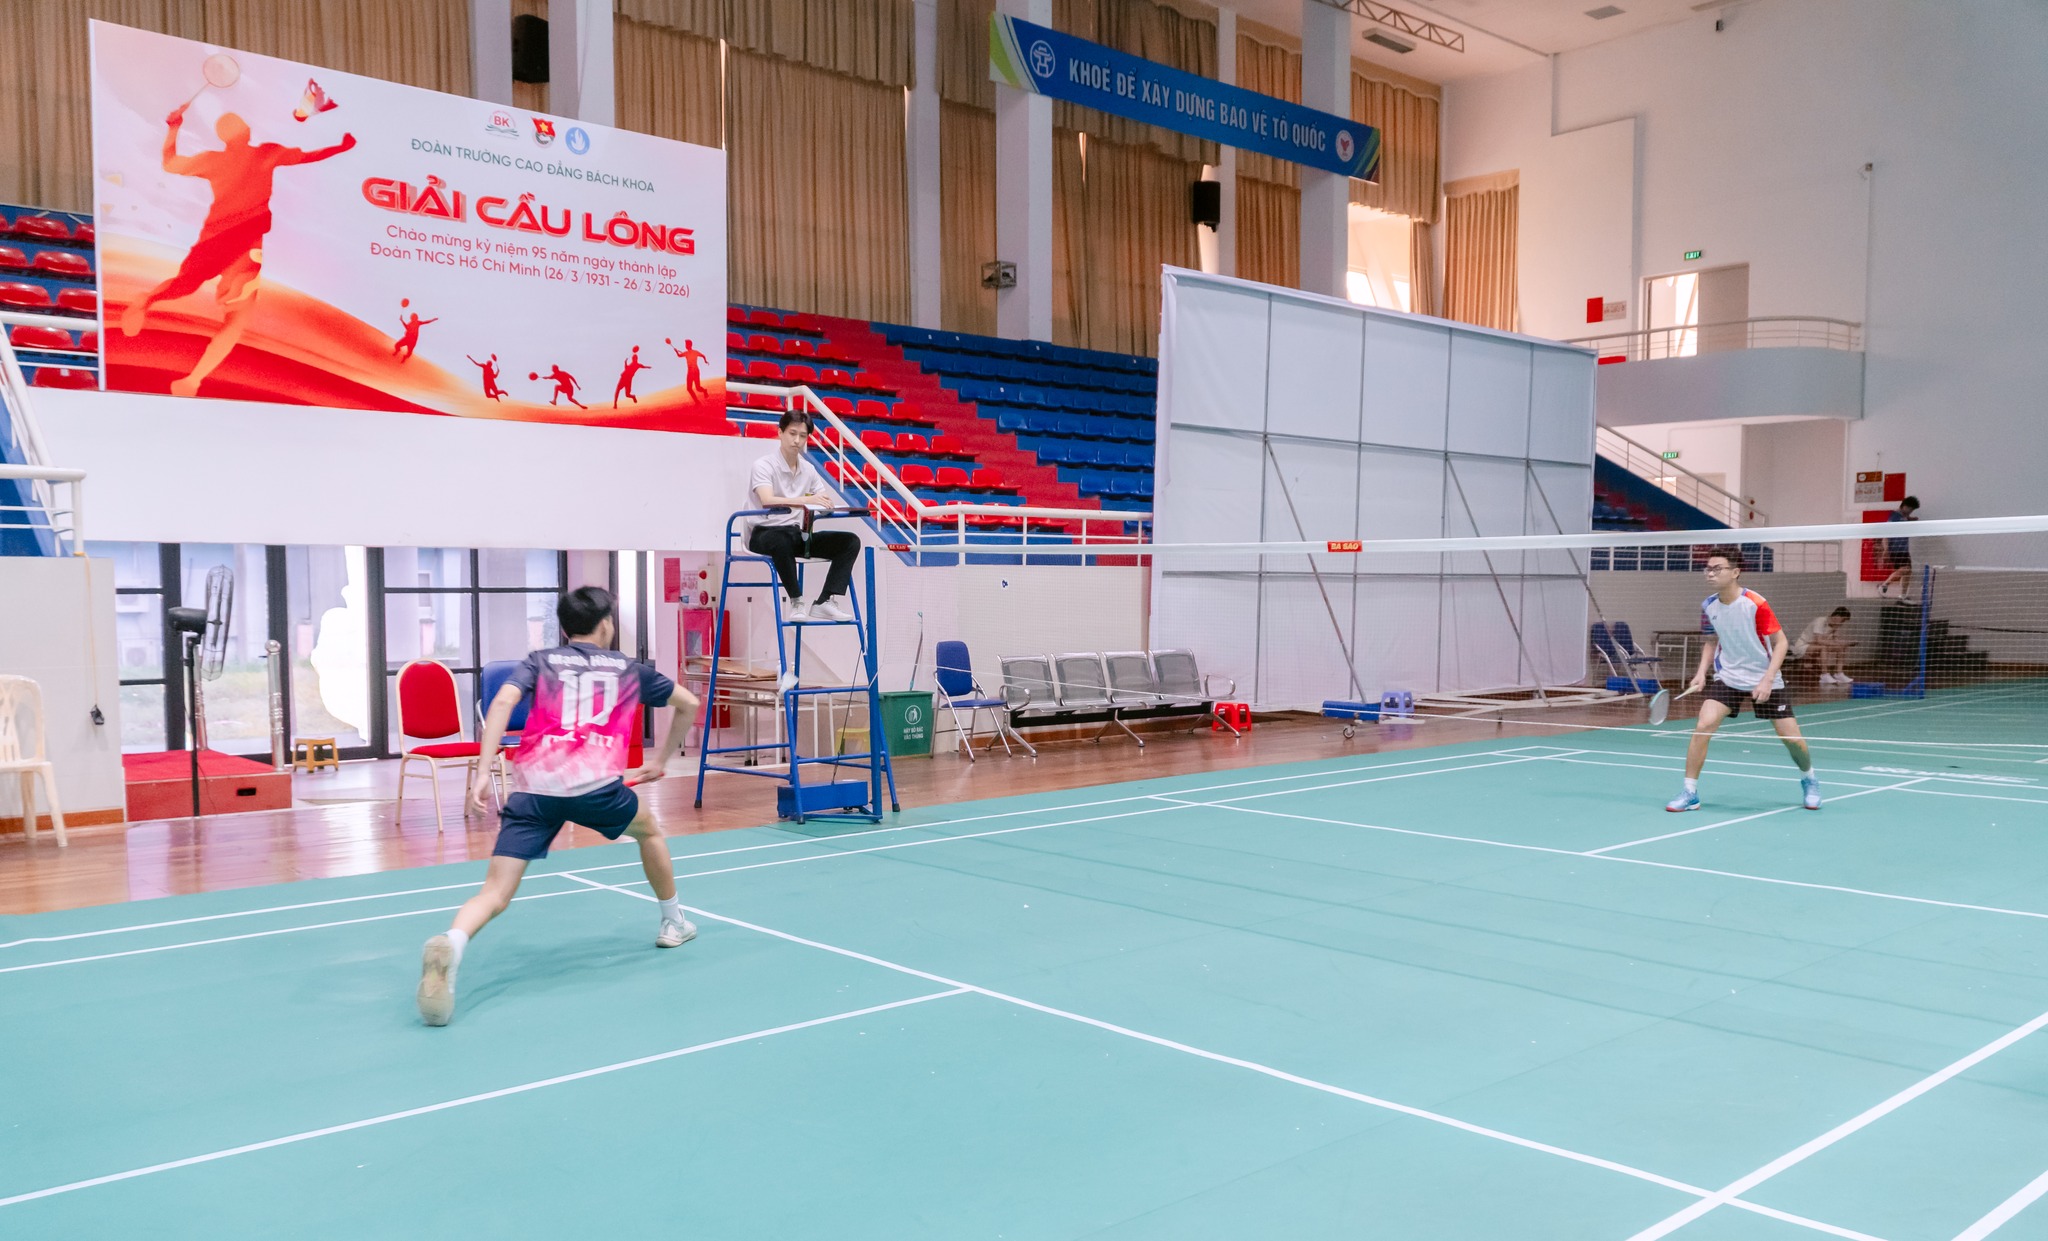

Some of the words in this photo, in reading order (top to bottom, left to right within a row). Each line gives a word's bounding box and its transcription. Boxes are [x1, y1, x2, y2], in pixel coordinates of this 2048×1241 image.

[494, 115, 510, 127] BK
[1069, 58, 1111, 92] KHOẺ
[1116, 67, 1137, 99] ĐỂ
[1141, 78, 1171, 109] XÂY
[1175, 89, 1215, 121] DỰNG
[1251, 109, 1268, 141] VỆ
[1292, 121, 1326, 152] QUỐC
[411, 138, 452, 156] ĐOÀN
[455, 146, 512, 167] TRƯỜNG
[515, 158, 543, 173] CAO
[547, 160, 583, 180] ĐẲNG
[586, 169, 619, 186] BÁCH
[622, 177, 655, 193] KHOA
[361, 173, 467, 223] GIẢI
[475, 192, 572, 238] CẦU
[581, 210, 695, 256] LÔNG
[370, 242, 411, 260] Đoàn
[415, 248, 455, 266] TNCS
[482, 258, 505, 273] Chí
[509, 261, 540, 277] Minh
[544, 265, 610, 287] (26/3/1931
[623, 277, 690, 298] 26/3/2026)
[386, 224, 427, 242] Chào
[432, 233, 472, 252] mừng
[475, 238, 491, 254] kỷ
[495, 242, 528, 259] niệm
[531, 245, 547, 260] 95
[551, 250, 580, 264] năm
[583, 256, 615, 271] ngày
[619, 260, 654, 275] thành
[657, 264, 677, 280] lập
[558, 669, 620, 730] 10
